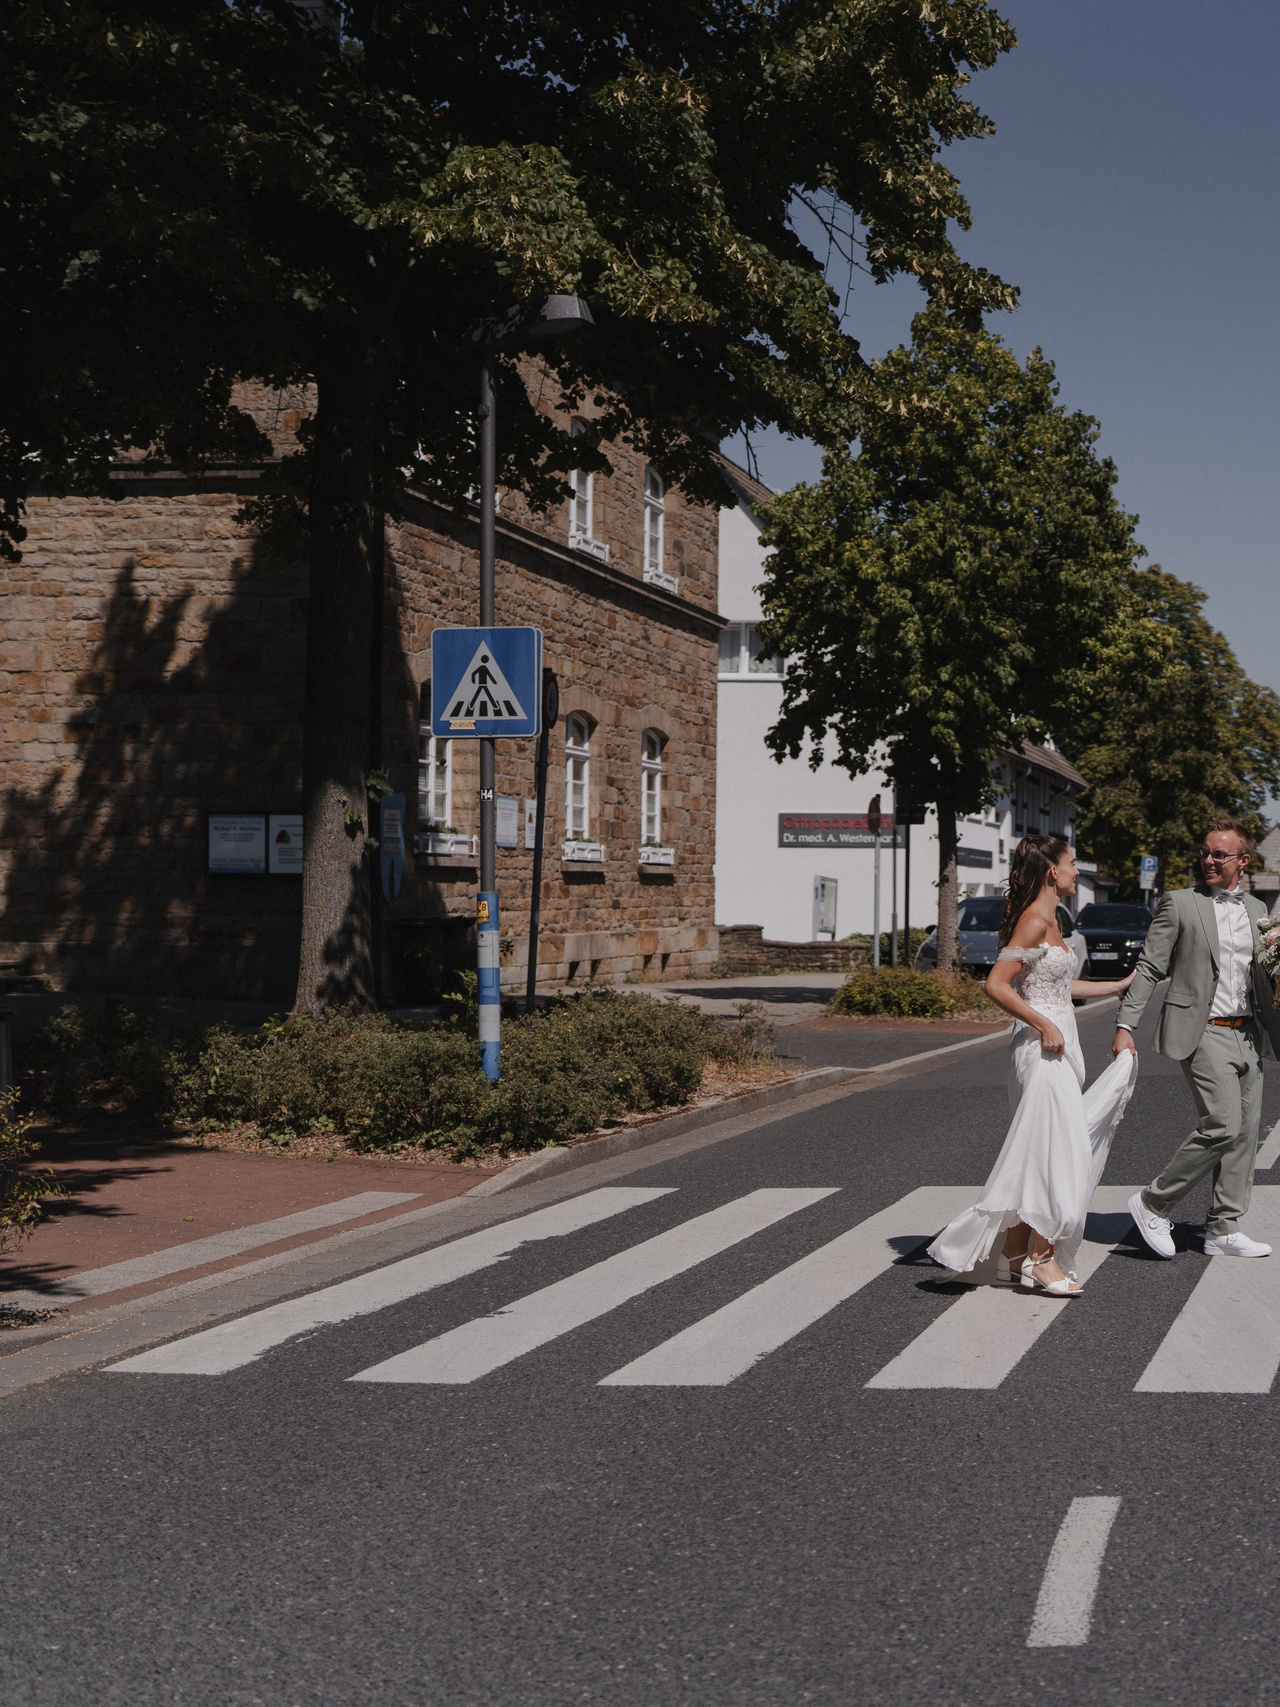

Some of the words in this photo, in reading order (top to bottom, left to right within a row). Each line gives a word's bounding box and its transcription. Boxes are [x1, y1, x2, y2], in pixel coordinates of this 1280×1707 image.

[481, 789, 494, 800] H4
[783, 833, 797, 842] Dr.
[798, 833, 825, 842] med.
[826, 833, 838, 842] A.
[1144, 858, 1154, 870] P
